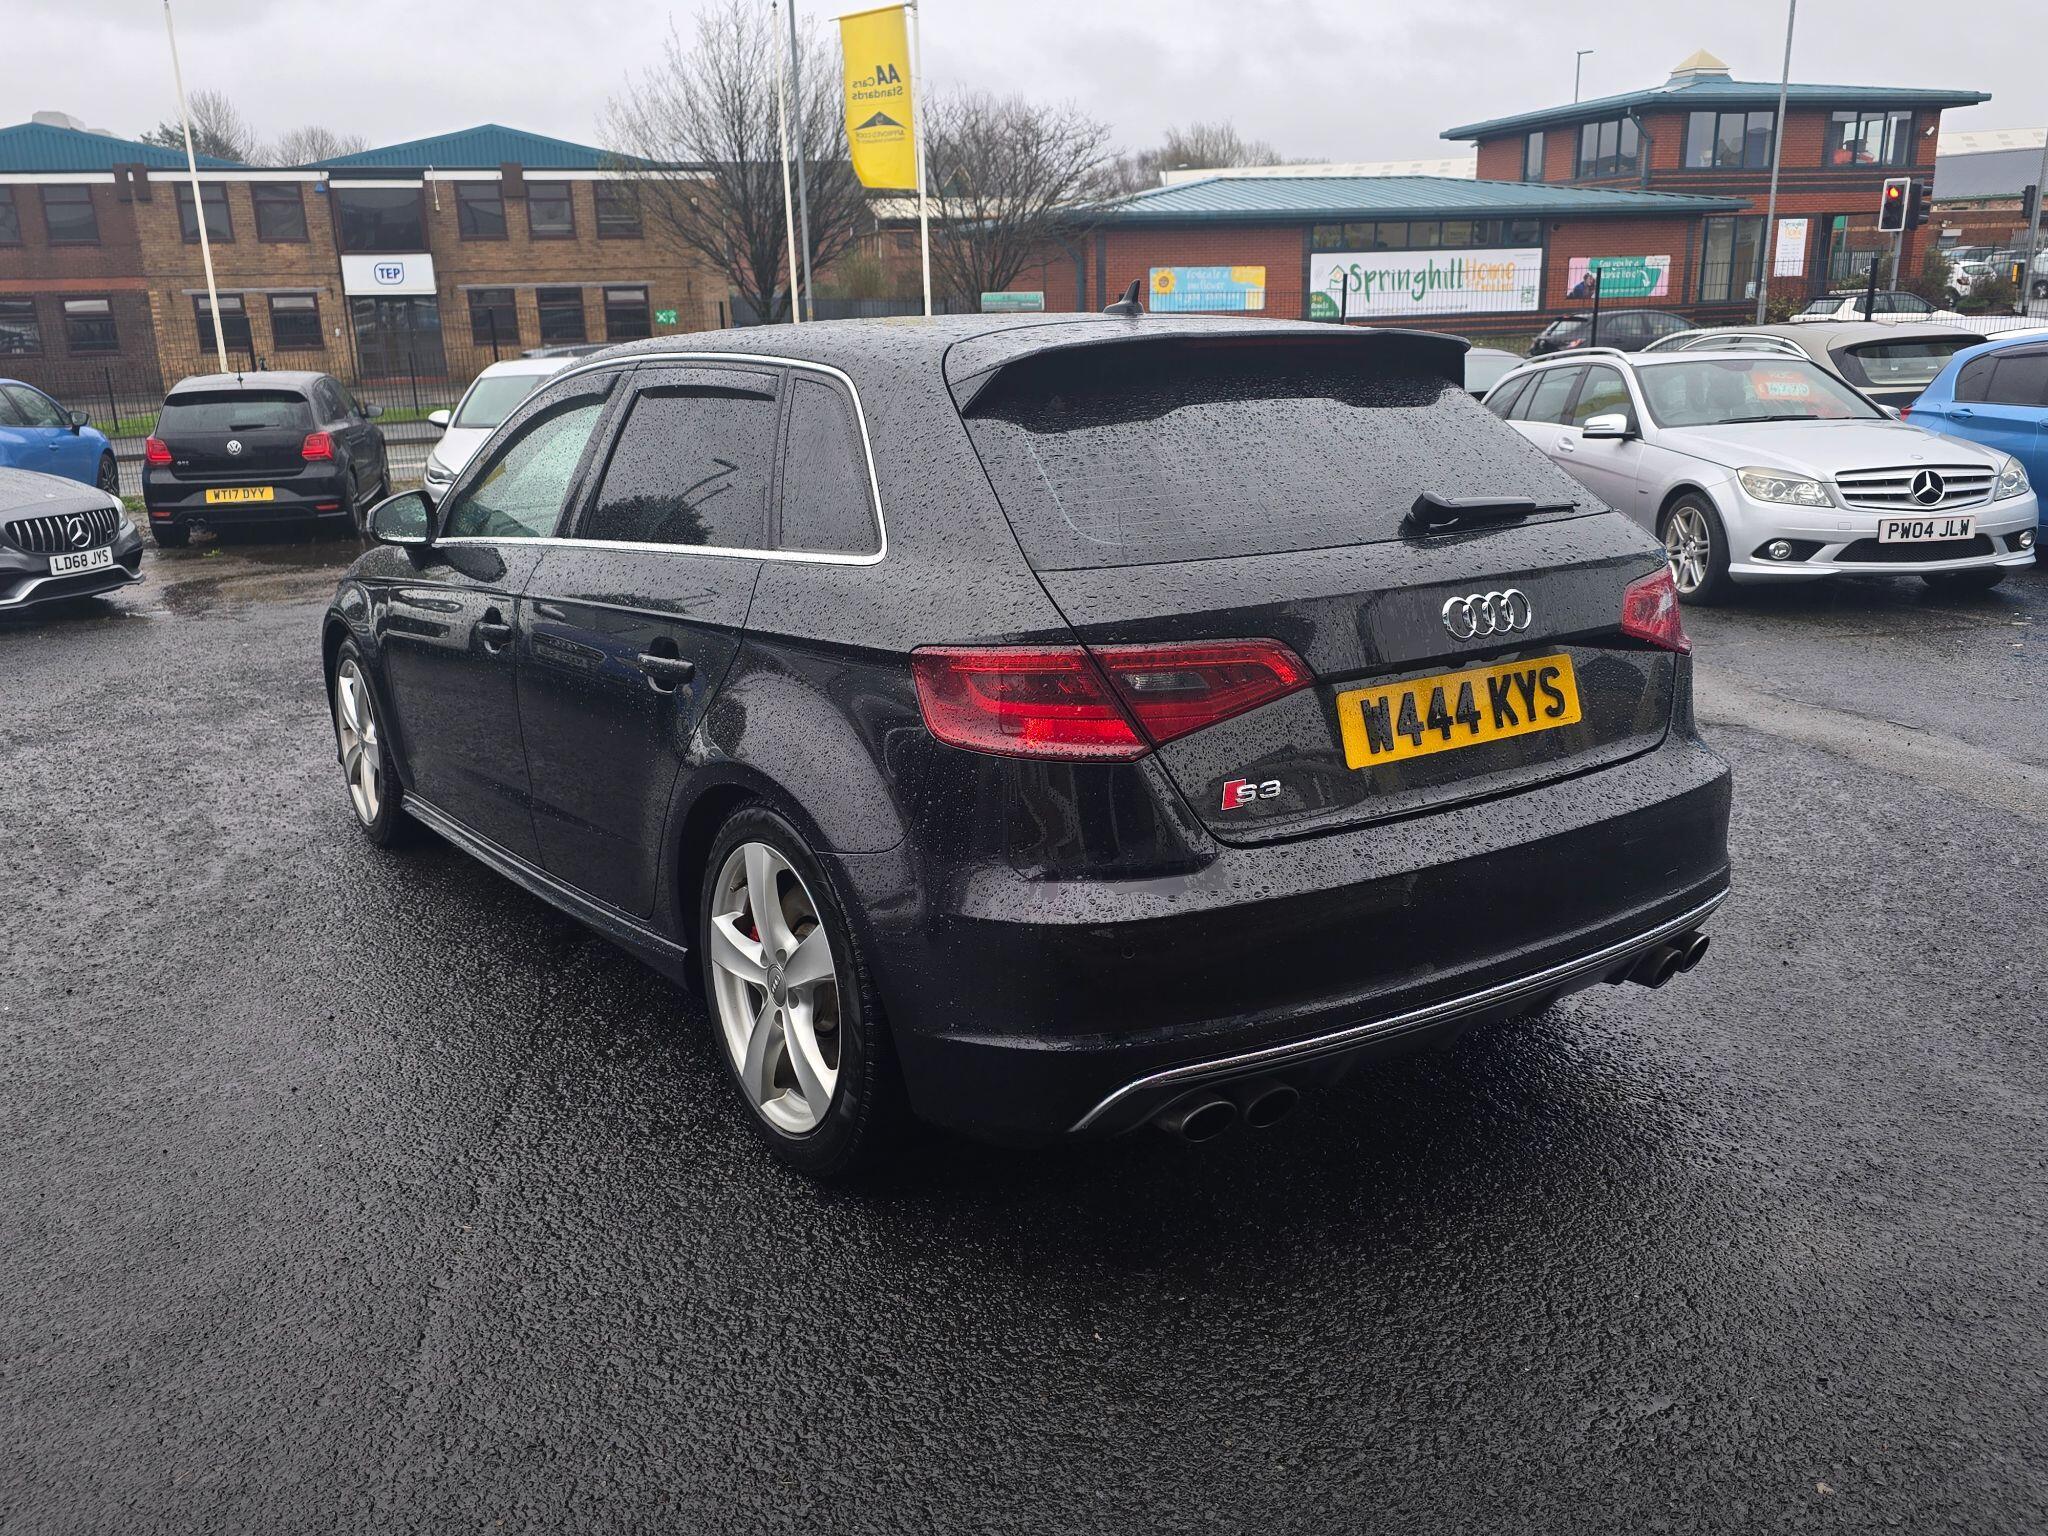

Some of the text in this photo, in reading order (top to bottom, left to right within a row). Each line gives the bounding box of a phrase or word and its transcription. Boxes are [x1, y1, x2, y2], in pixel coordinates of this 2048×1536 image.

[379, 268, 400, 279] TEP
[1350, 257, 1463, 303] Springhill
[213, 488, 265, 500] WT17 DYY
[1887, 519, 1970, 539] PW04 JLW
[54, 549, 109, 571] LD68 JYS
[1360, 666, 1566, 755] W444 KYS
[1236, 779, 1281, 803] S3
